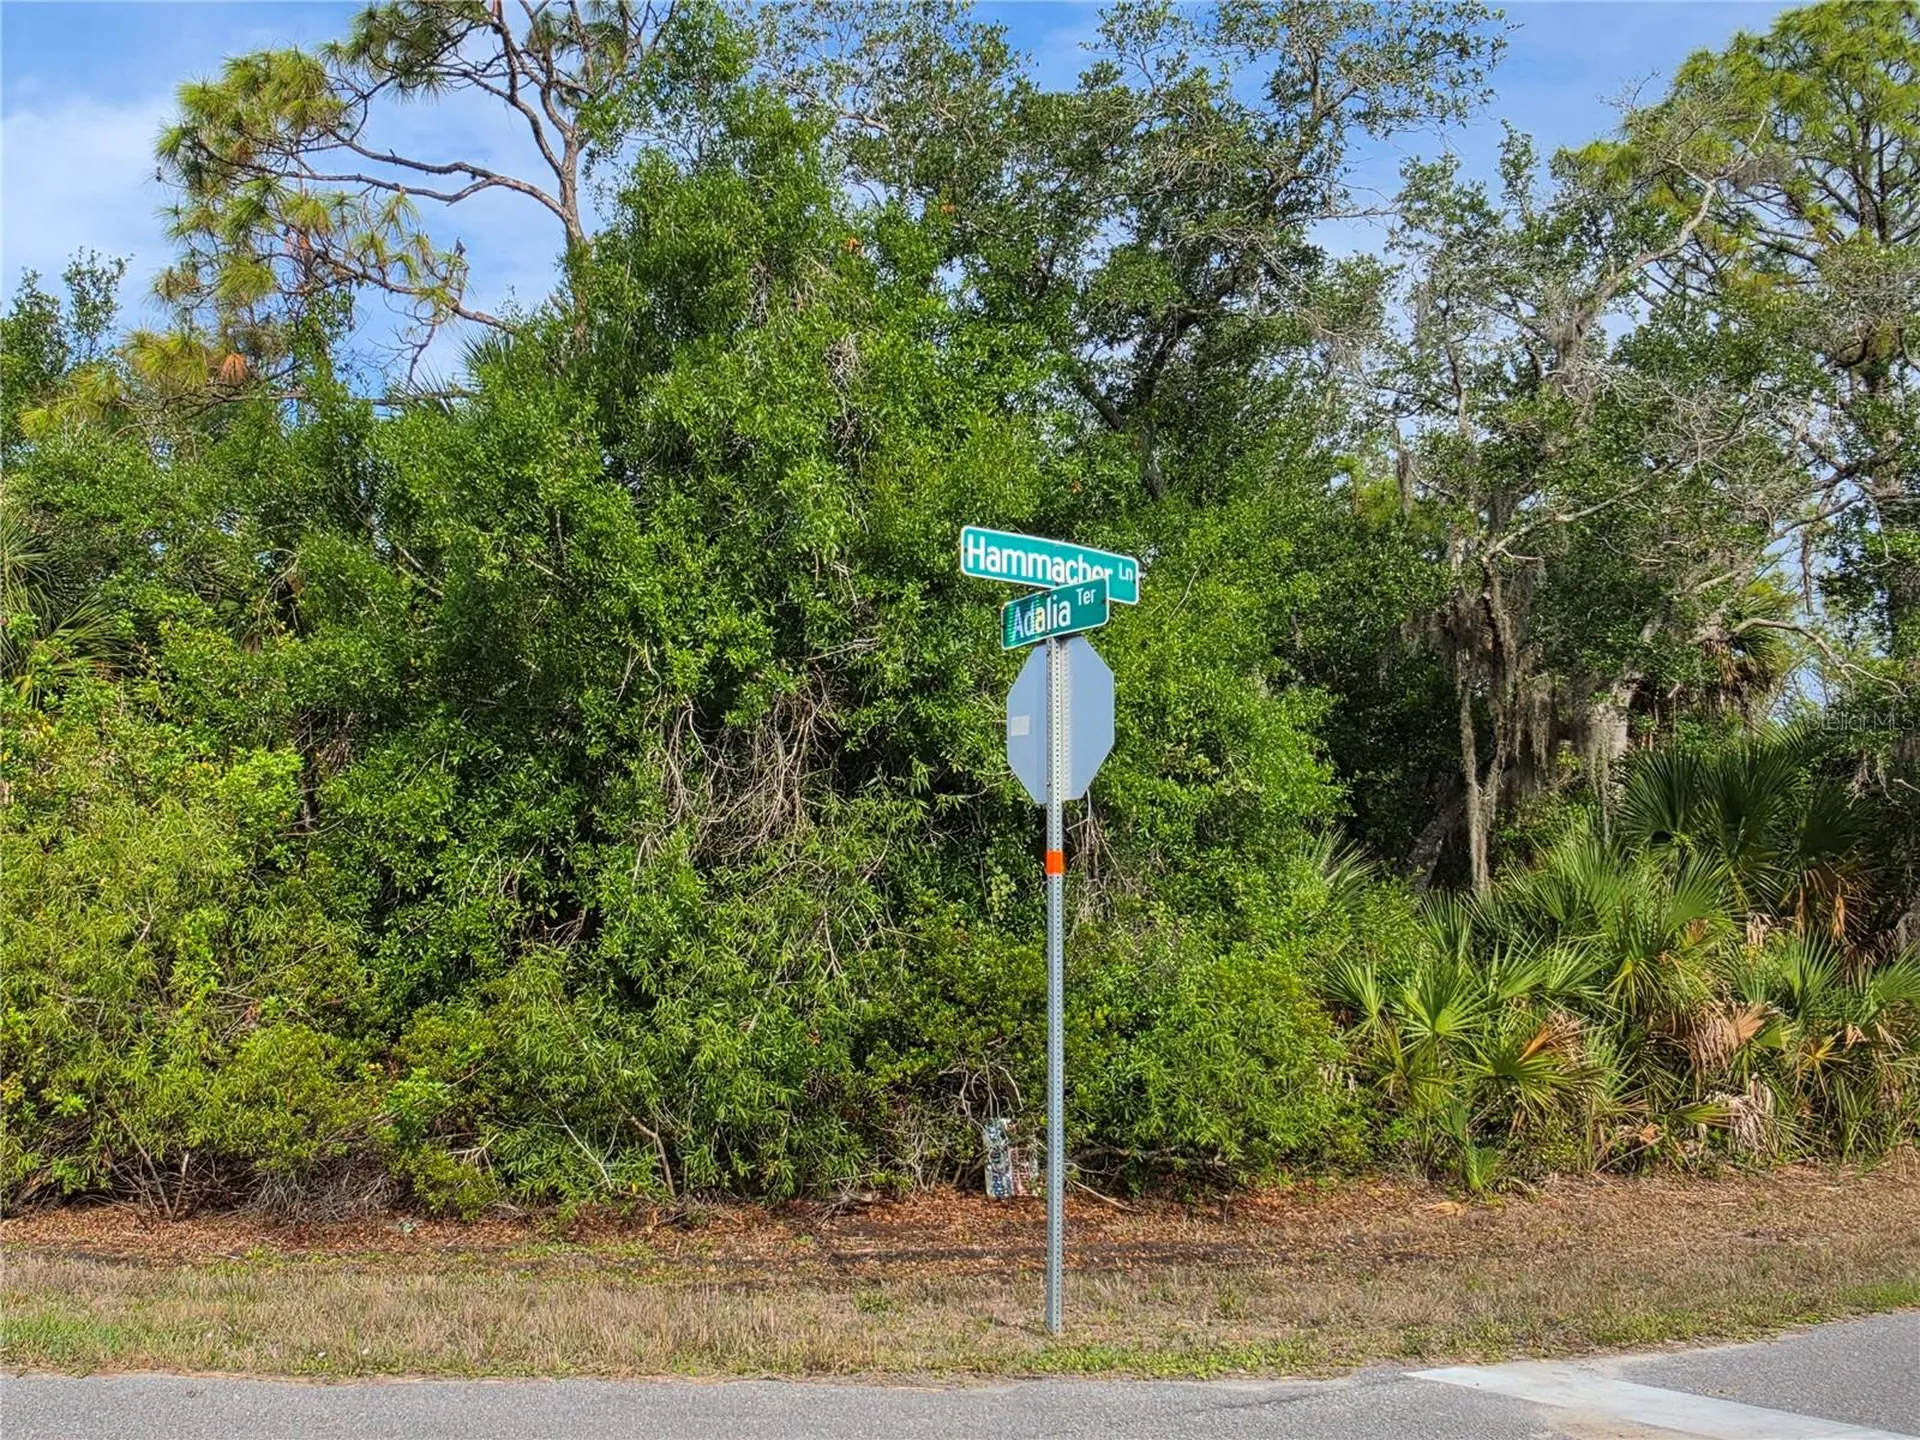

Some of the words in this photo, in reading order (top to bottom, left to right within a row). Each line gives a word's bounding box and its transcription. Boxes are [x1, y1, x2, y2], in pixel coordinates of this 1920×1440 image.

[1118, 562, 1133, 582] Ln
[1012, 595, 1071, 641] Adalia
[1076, 587, 1096, 606] Ter
